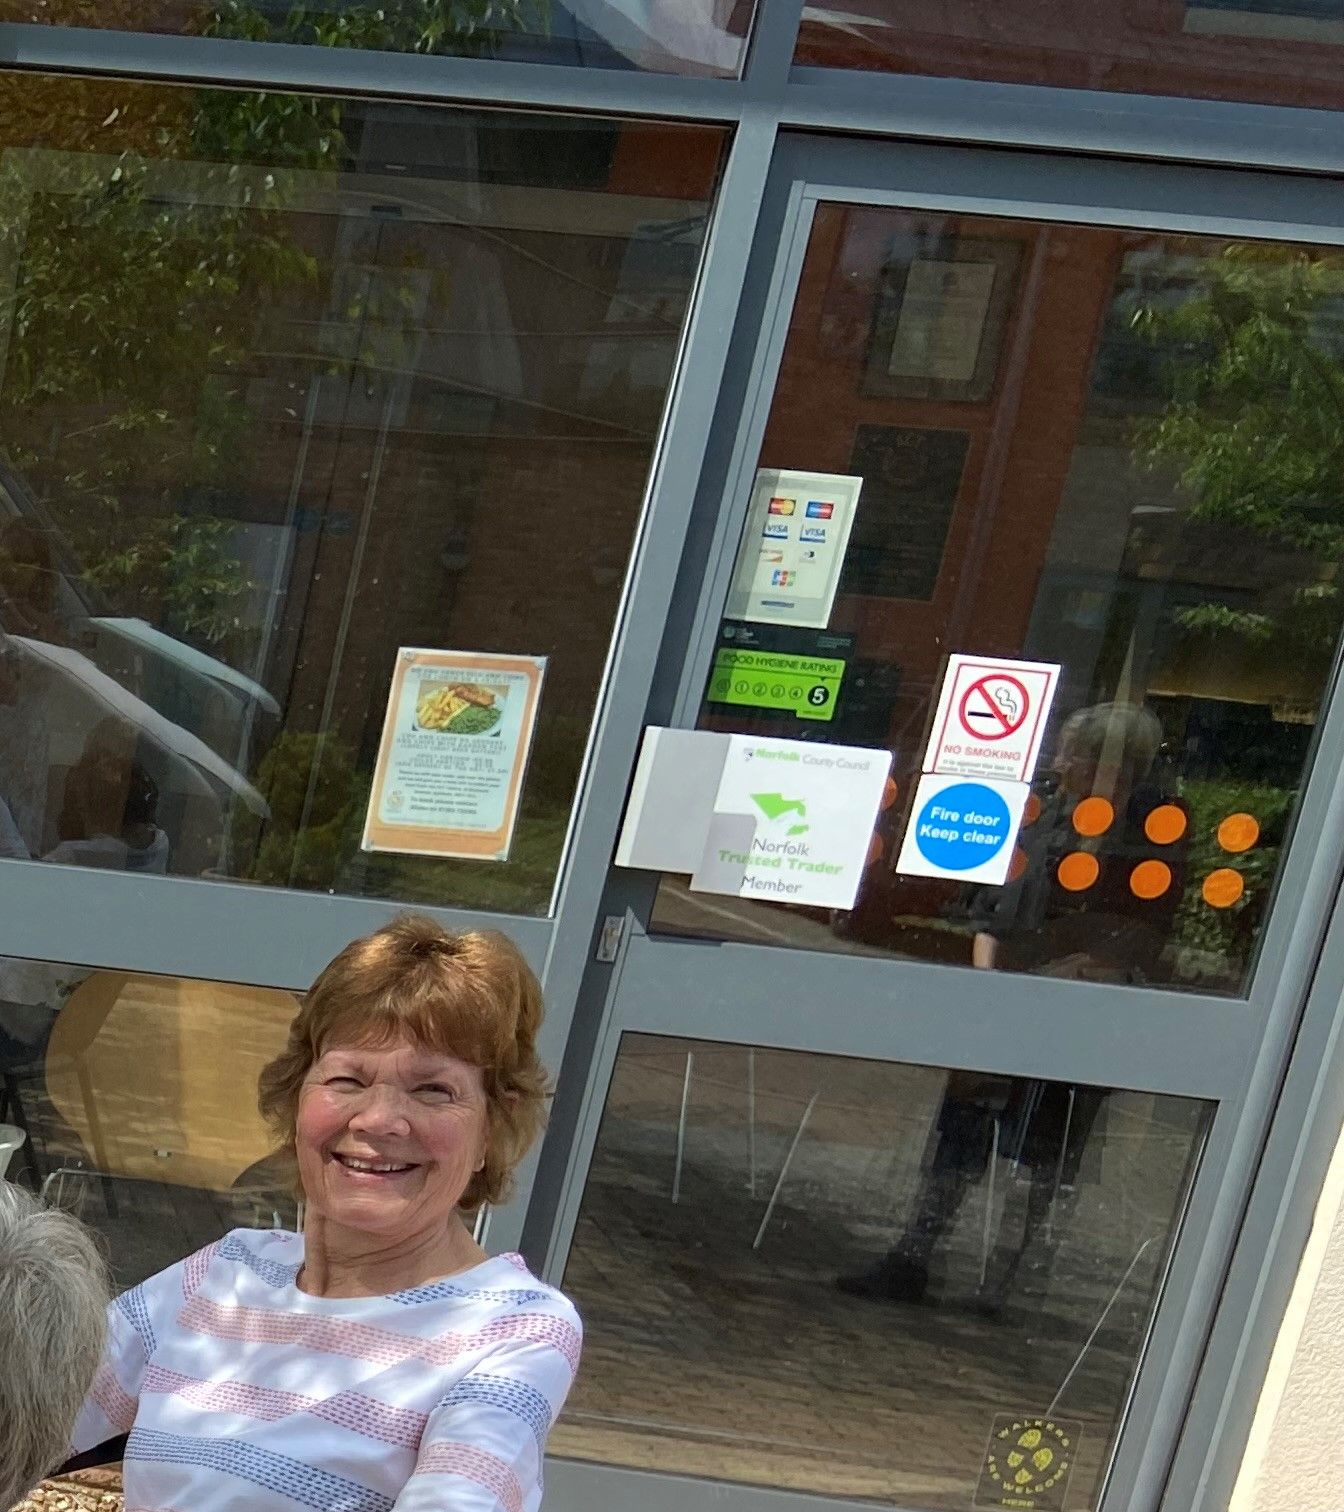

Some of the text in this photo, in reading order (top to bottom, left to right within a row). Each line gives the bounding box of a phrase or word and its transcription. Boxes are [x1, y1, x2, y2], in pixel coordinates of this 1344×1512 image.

[768, 524, 788, 533] VISA
[805, 528, 826, 537] VISA
[723, 653, 838, 674] FOOD HYGIENE RATING
[812, 688, 825, 704] 5
[756, 748, 871, 771] Norfolk County Council
[944, 745, 1021, 761] NO SMOKING
[931, 806, 1001, 827] Fire door
[920, 824, 1001, 845] Keep clear
[753, 838, 810, 856] Norfolk
[787, 858, 845, 875] Trader
[741, 875, 803, 894] Member
